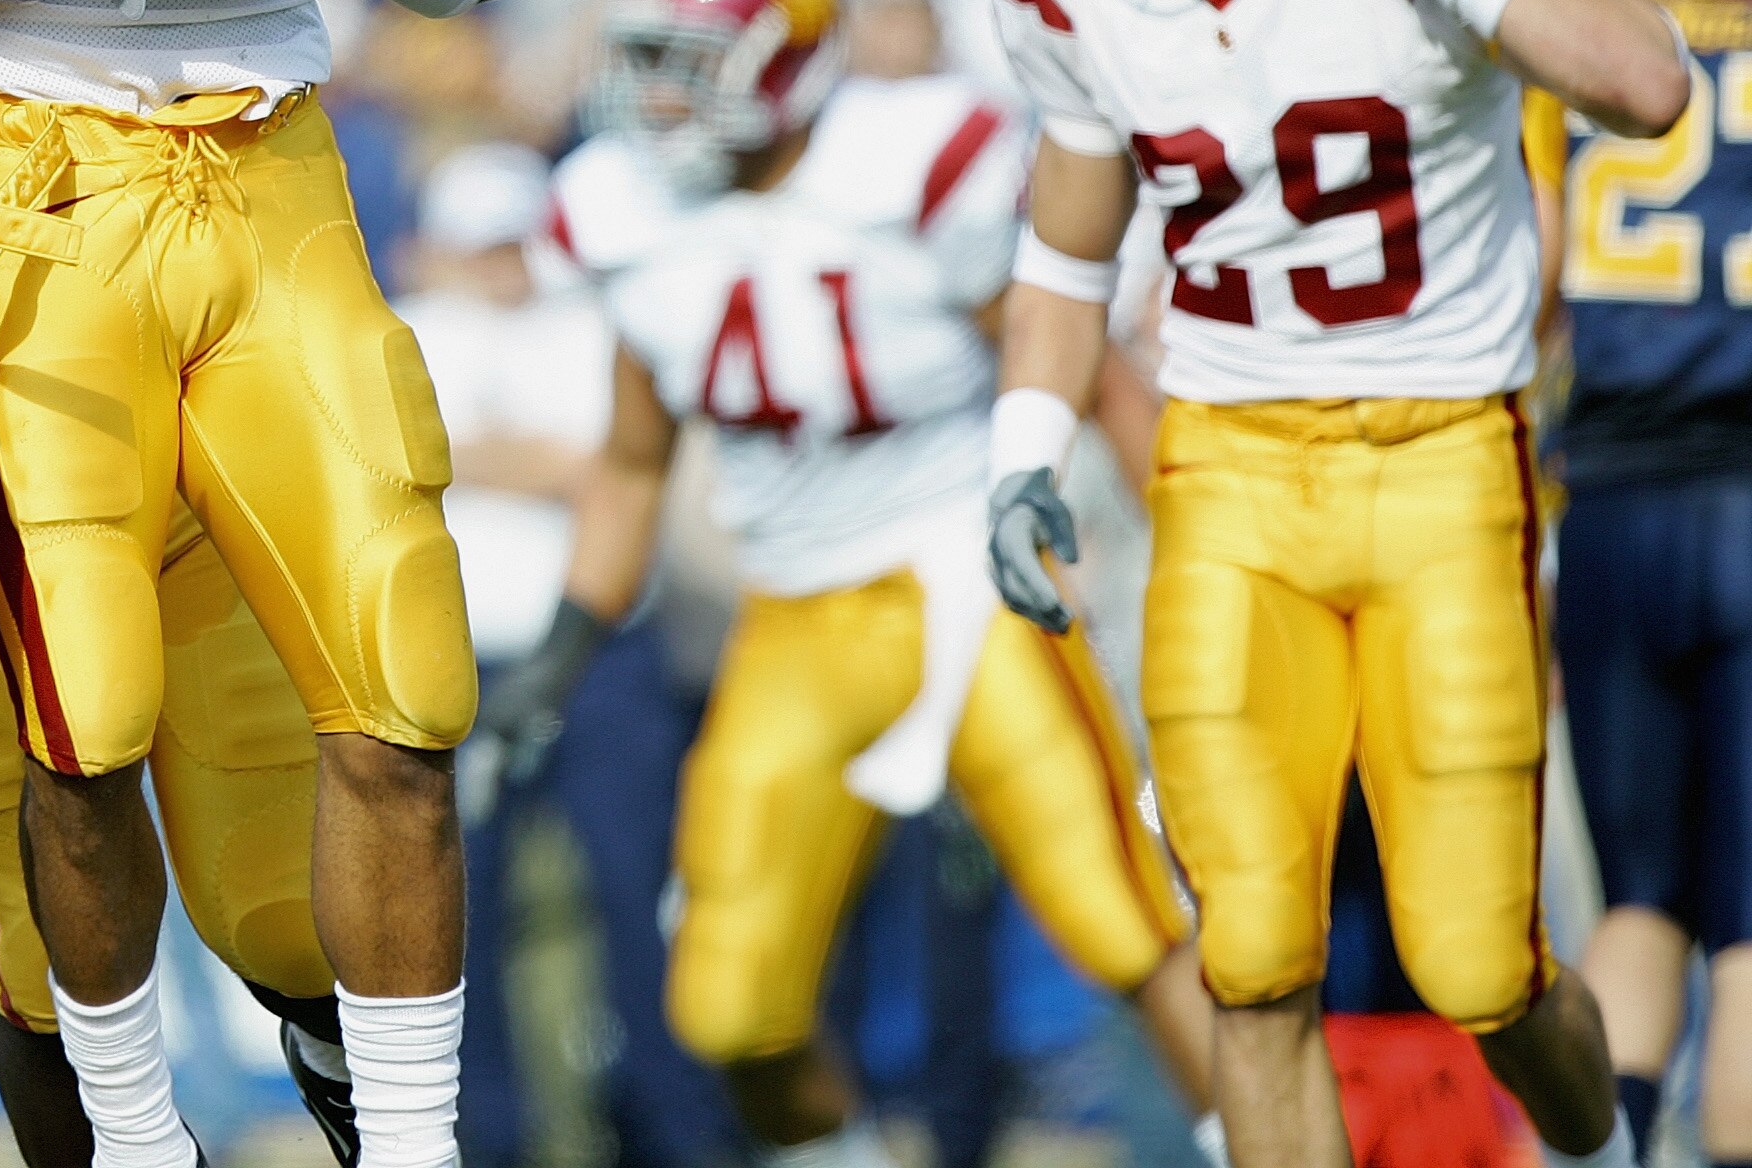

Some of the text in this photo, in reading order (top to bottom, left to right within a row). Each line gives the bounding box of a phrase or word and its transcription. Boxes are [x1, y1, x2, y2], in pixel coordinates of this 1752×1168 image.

[1130, 96, 1422, 326] 29
[1561, 50, 1752, 309] 2
[701, 270, 895, 443] 41
